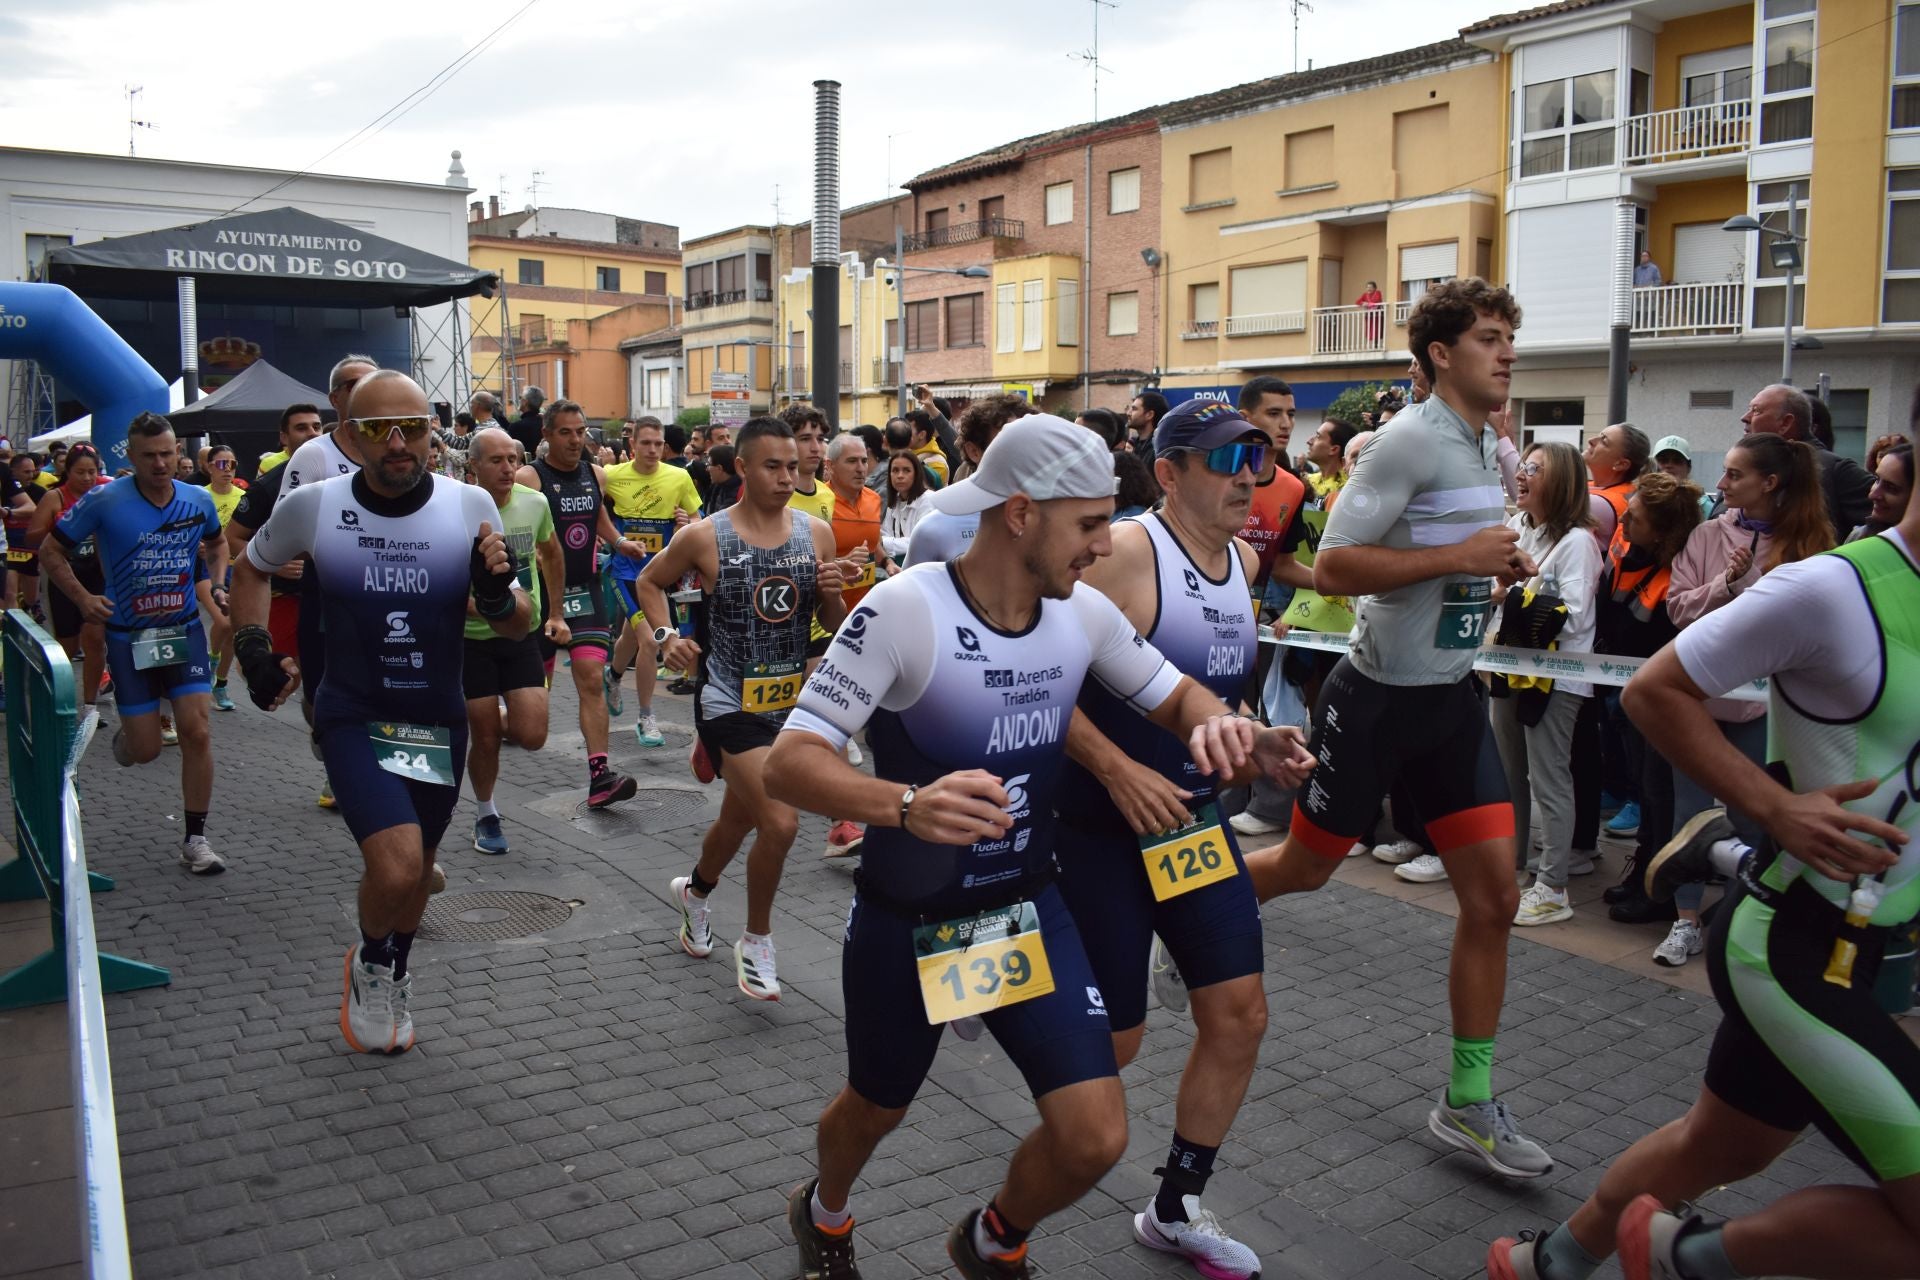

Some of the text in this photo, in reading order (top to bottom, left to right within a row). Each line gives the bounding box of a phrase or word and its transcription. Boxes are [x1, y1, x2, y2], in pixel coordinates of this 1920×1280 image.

[215, 230, 362, 252] AYUNTAMIENTO
[166, 249, 407, 279] RINCON DE SOTO
[560, 495, 594, 512] SEVERO
[137, 531, 189, 545] ARRIAZU
[387, 539, 430, 551] Arenas
[373, 551, 417, 563] Triatlón
[775, 555, 811, 568] K-TEAM
[363, 565, 430, 595] ALFARO
[137, 594, 182, 611] SANDUA
[562, 599, 581, 613] 15
[1220, 612, 1245, 625] Arenas
[1458, 613, 1484, 638] 37
[1213, 626, 1239, 639] Triatlón
[149, 644, 175, 661] 13
[379, 655, 408, 663] Tudela
[1206, 645, 1245, 677] GARCIA
[822, 663, 873, 706] Arenas
[1016, 665, 1063, 686] Arenas
[752, 681, 794, 705] 129
[1002, 687, 1050, 707] Triatlón
[985, 706, 1061, 755] ANDONI
[393, 750, 431, 773] 24
[972, 840, 1010, 853] Tudela
[1159, 841, 1222, 883] 126
[940, 949, 1032, 1001] 139
